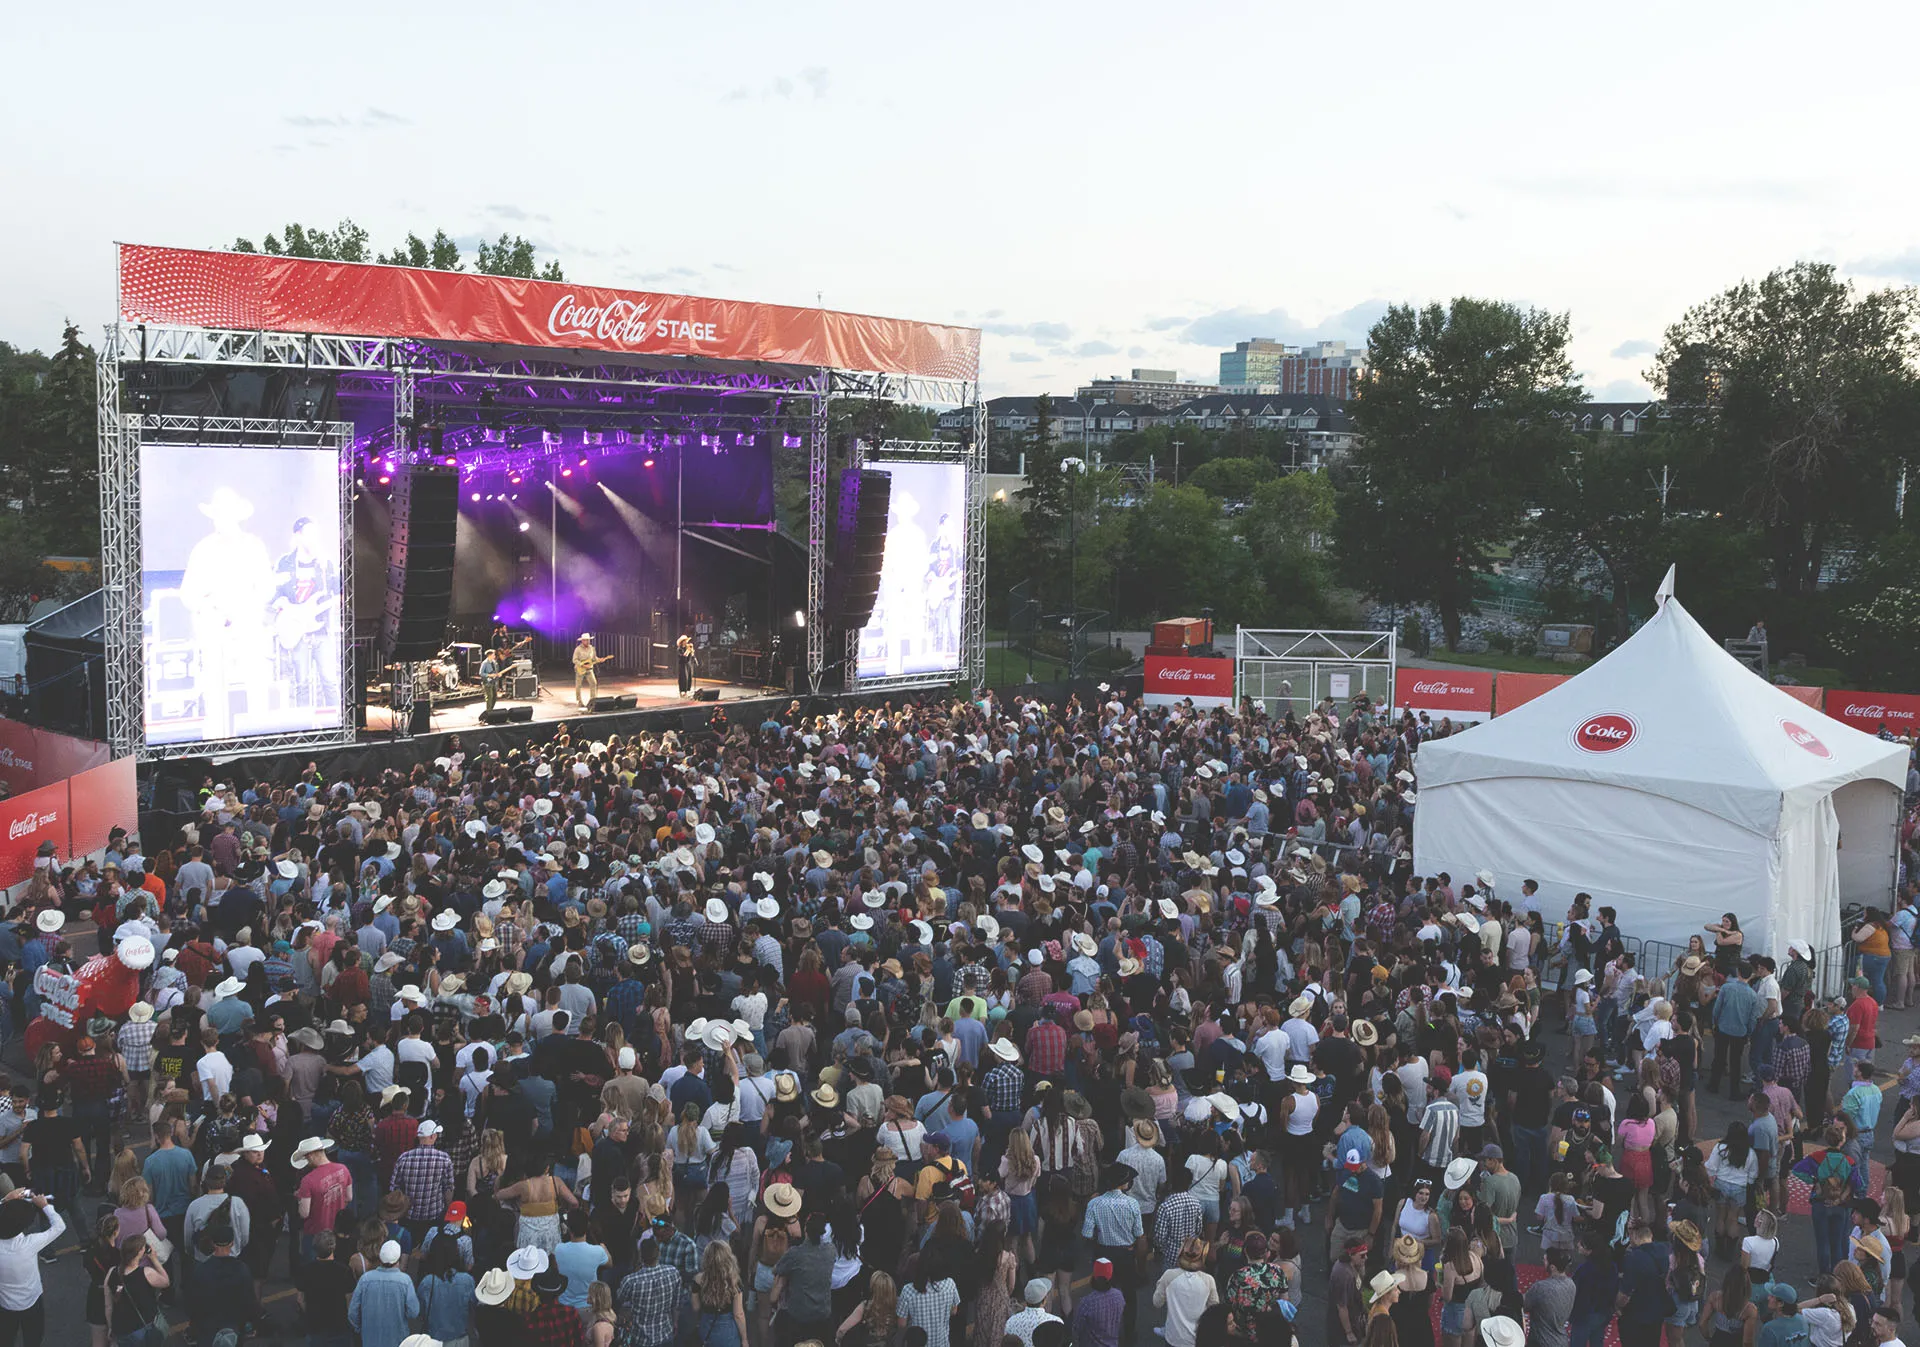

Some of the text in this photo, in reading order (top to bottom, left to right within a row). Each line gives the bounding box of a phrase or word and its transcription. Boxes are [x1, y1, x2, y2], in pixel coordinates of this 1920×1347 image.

[548, 295, 717, 342] Coca-Cola STAGE
[1193, 673, 1216, 681] STAGE
[1887, 711, 1914, 719] STAGE
[1585, 724, 1628, 739] Coke
[39, 812, 57, 826] STAGE
